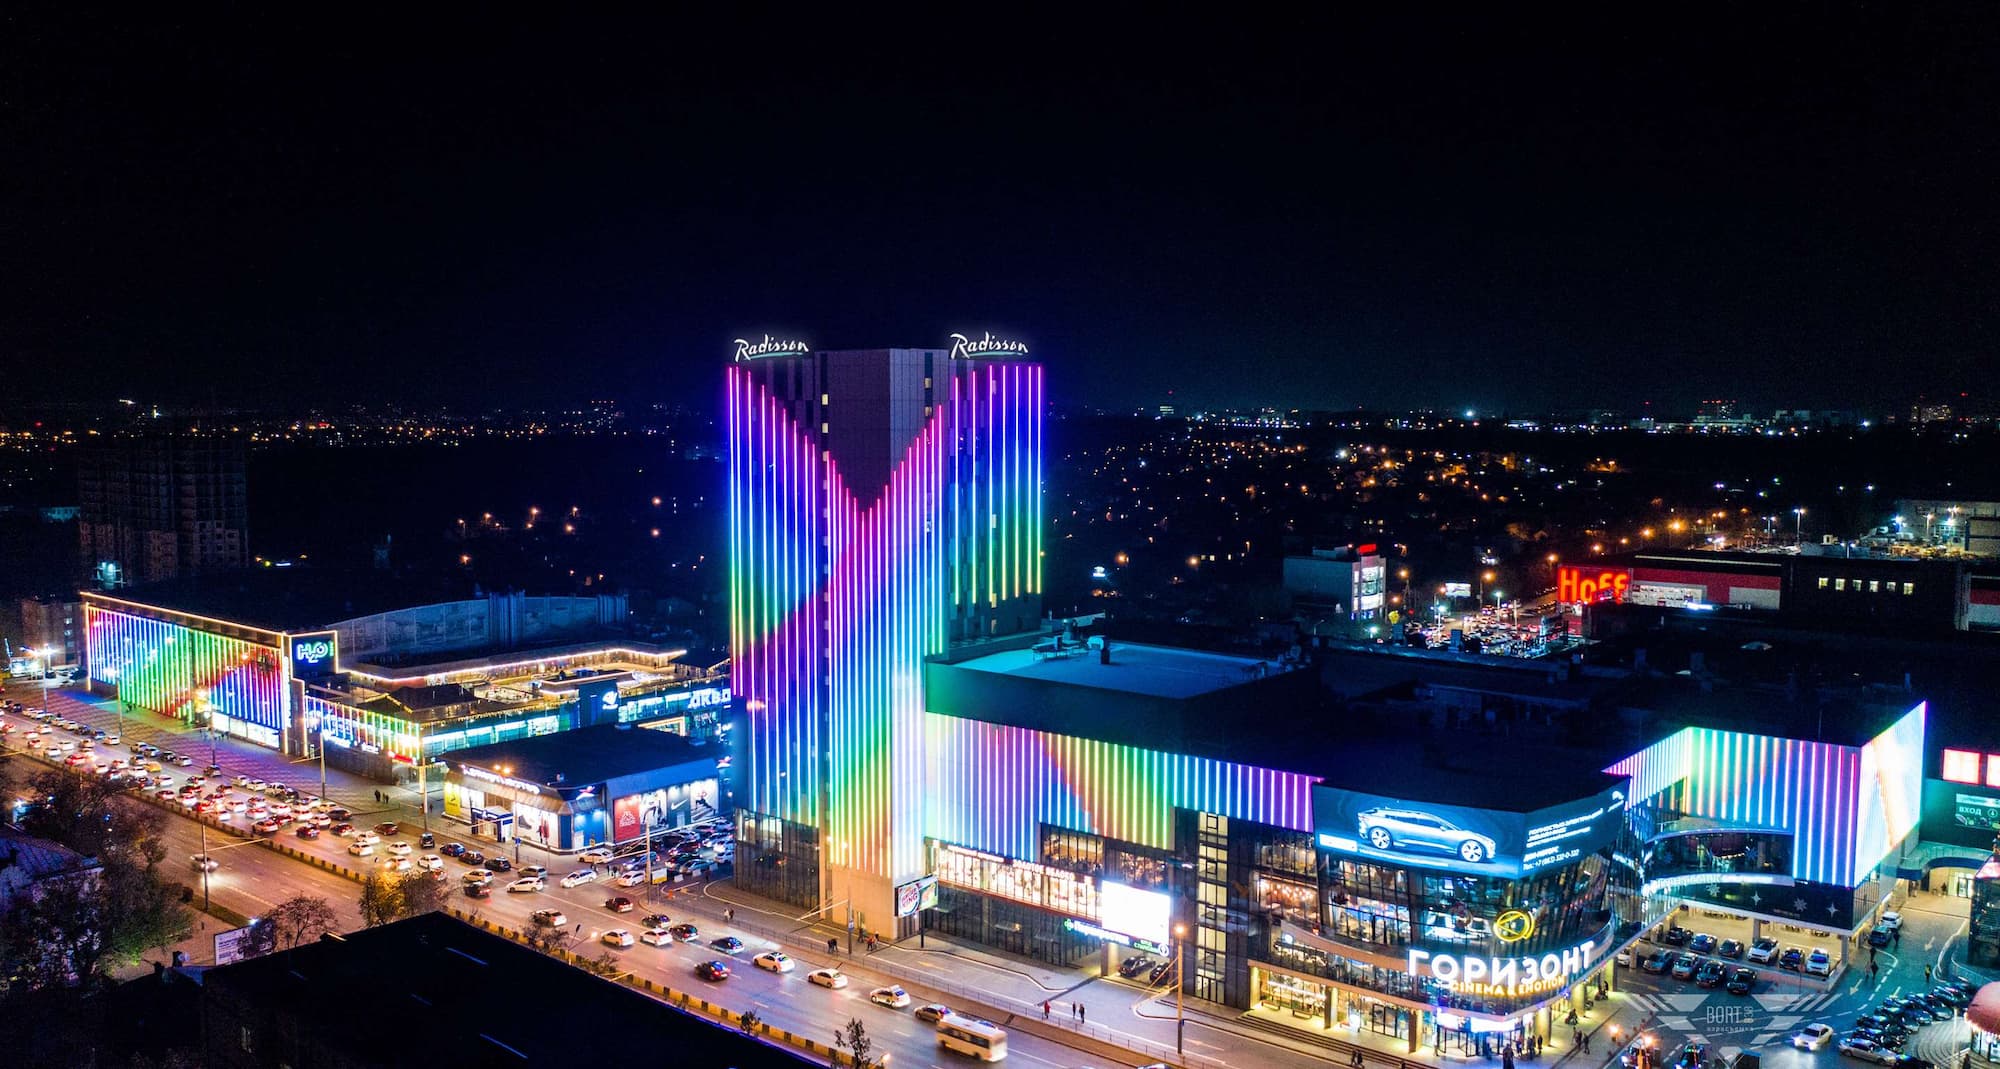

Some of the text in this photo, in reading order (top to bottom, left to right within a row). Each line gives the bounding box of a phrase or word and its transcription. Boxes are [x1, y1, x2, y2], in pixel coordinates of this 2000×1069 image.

[734, 334, 809, 362] Radisson
[950, 331, 1029, 360] Radisson
[1559, 567, 1630, 603] Hoff
[1408, 940, 1595, 989] ГОРИЗОНТ
[1451, 980, 1504, 997] CINEMA
[1518, 975, 1567, 995] EMOTION
